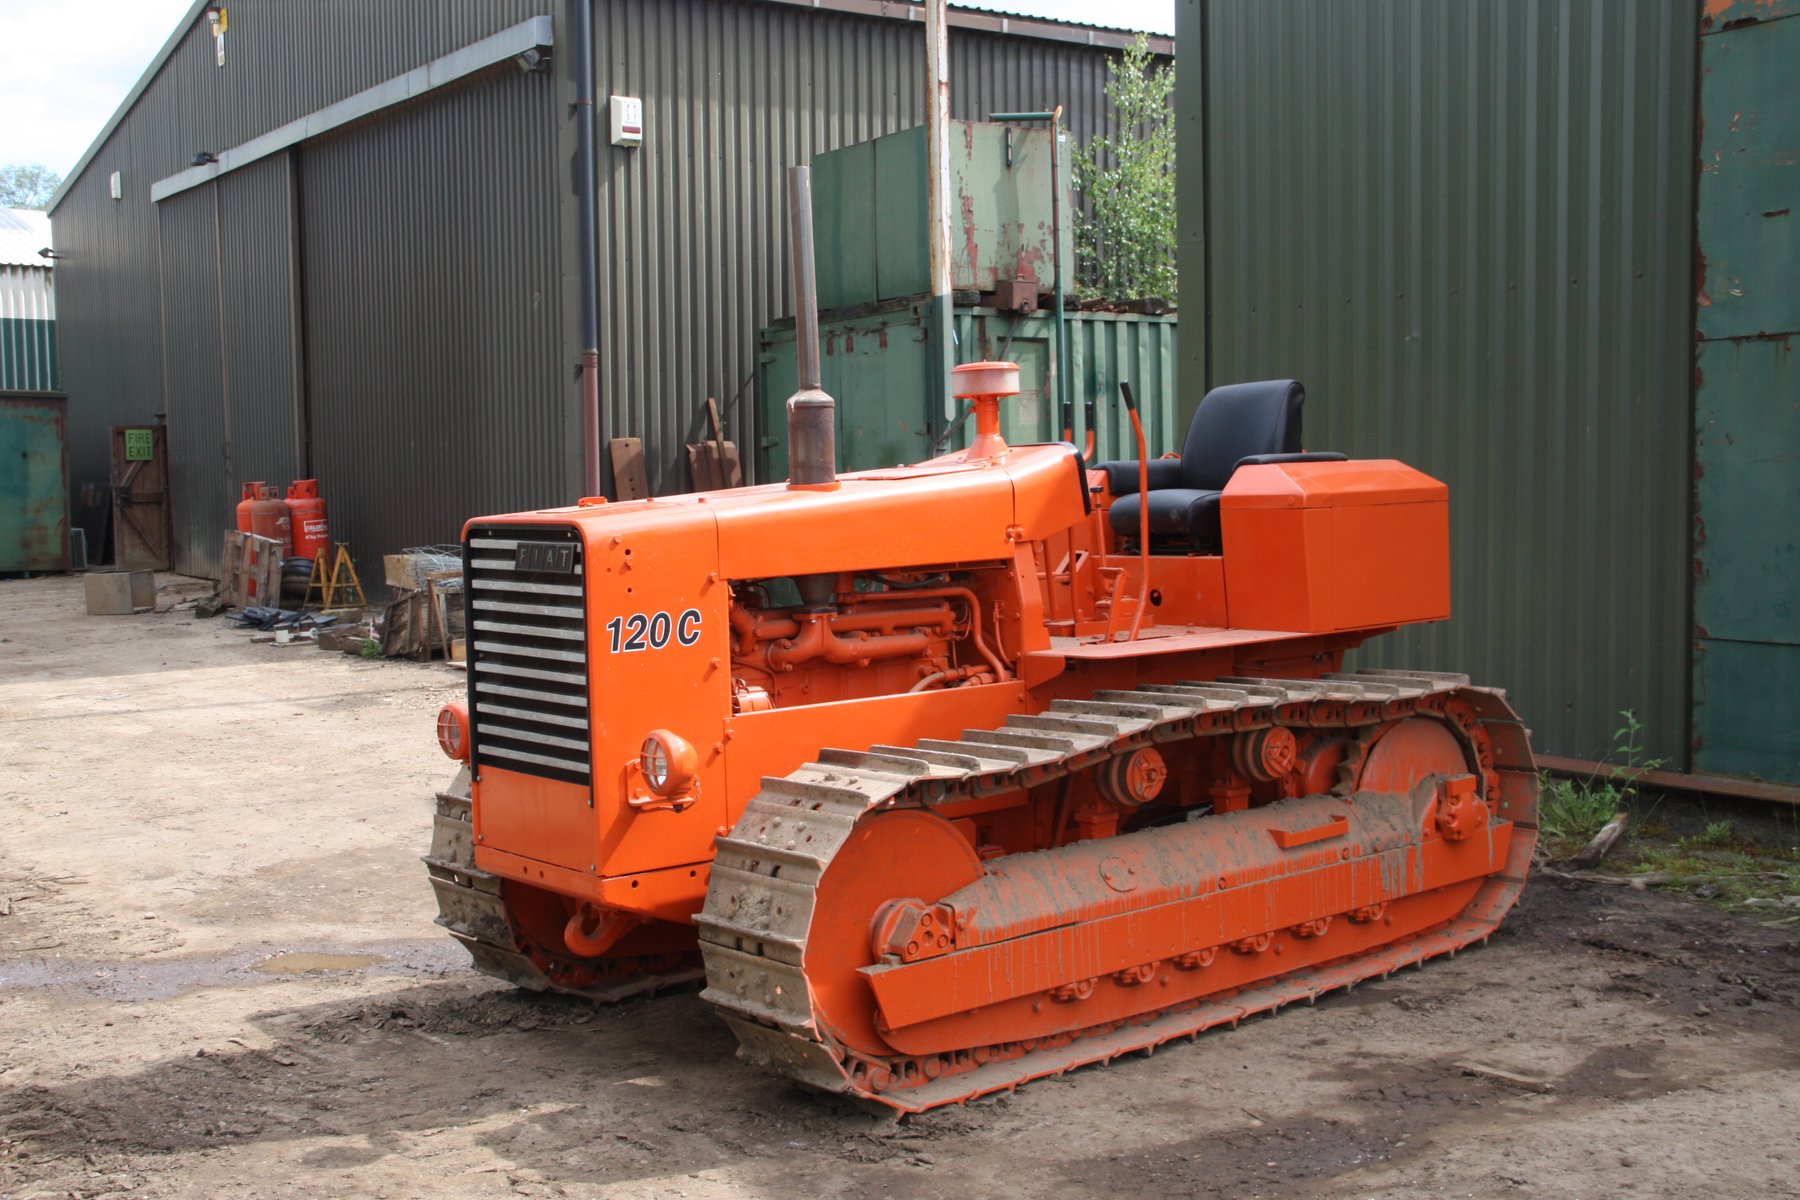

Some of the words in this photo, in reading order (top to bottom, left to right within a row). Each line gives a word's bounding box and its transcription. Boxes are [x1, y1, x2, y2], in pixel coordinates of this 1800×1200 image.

[128, 432, 151, 444] FIRE
[129, 446, 151, 457] EXIT
[520, 548, 569, 567] FIAT
[606, 611, 672, 653] 120
[677, 608, 702, 646] C
